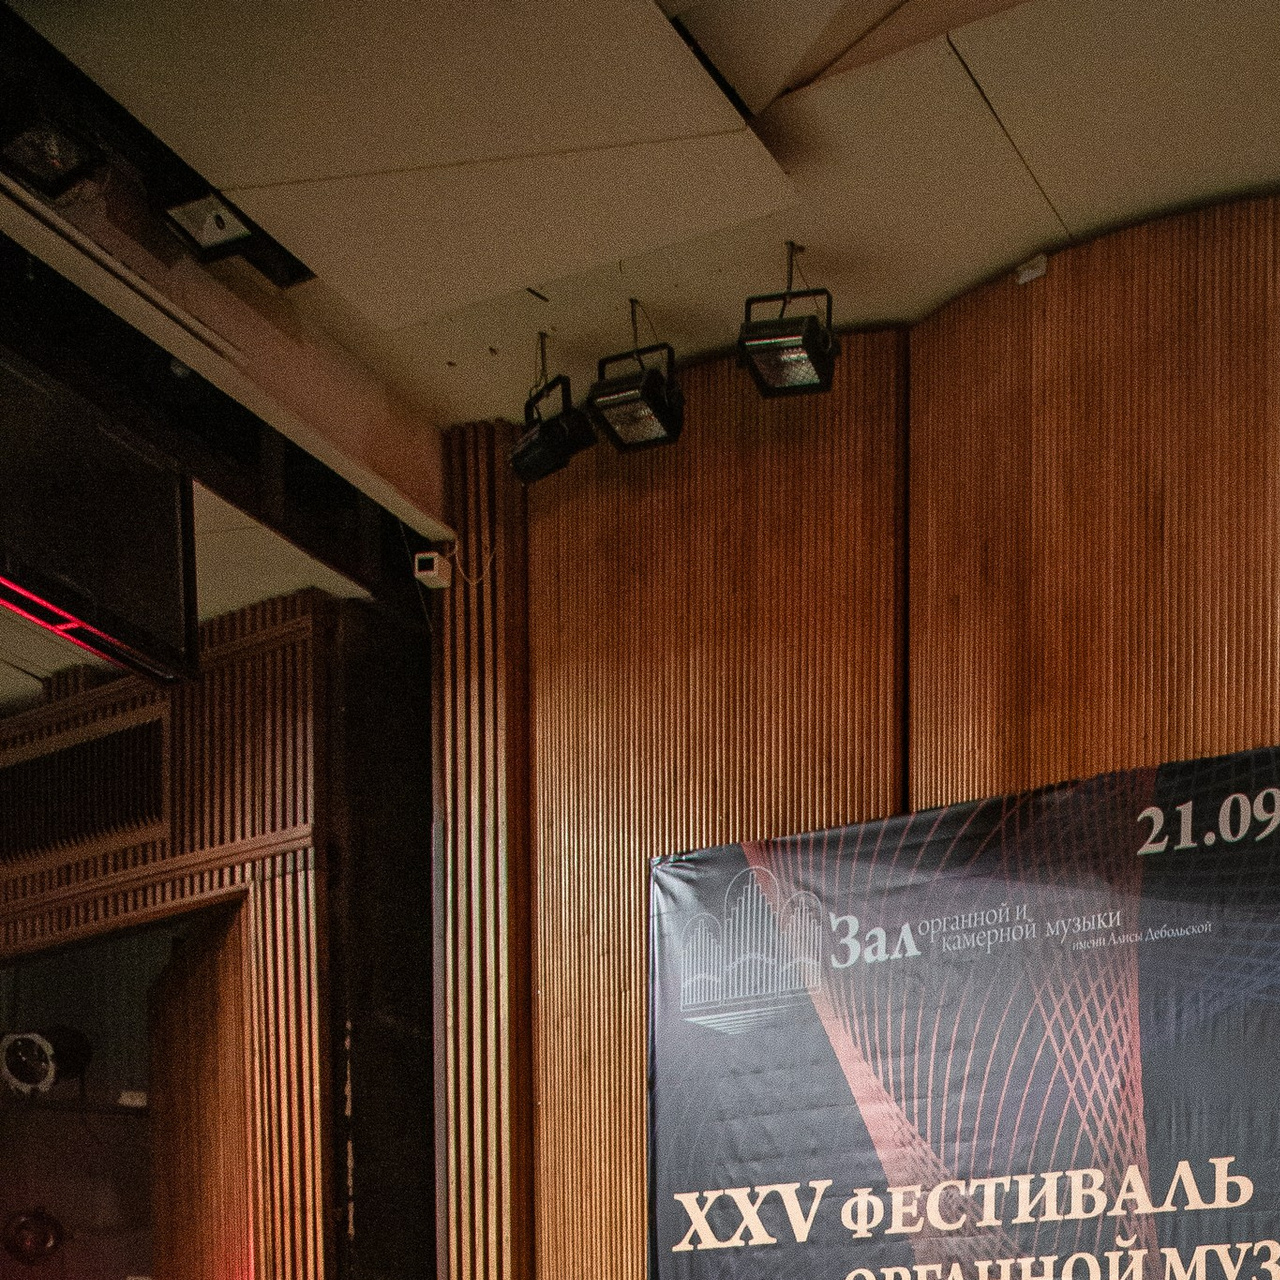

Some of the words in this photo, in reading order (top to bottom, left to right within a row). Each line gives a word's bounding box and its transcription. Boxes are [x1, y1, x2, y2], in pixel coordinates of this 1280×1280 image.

[829, 911, 922, 969] Зал
[918, 902, 1010, 943] органной
[1016, 904, 1027, 920] и
[942, 919, 1037, 954] камерной
[1046, 911, 1121, 944] музыки
[1072, 937, 1106, 951] имени
[1107, 931, 1143, 946] Алисы
[1145, 921, 1212, 942] Дебольской
[672, 1179, 833, 1252] XXV
[840, 1156, 1254, 1239] ФЕСТИВАЛЬ
